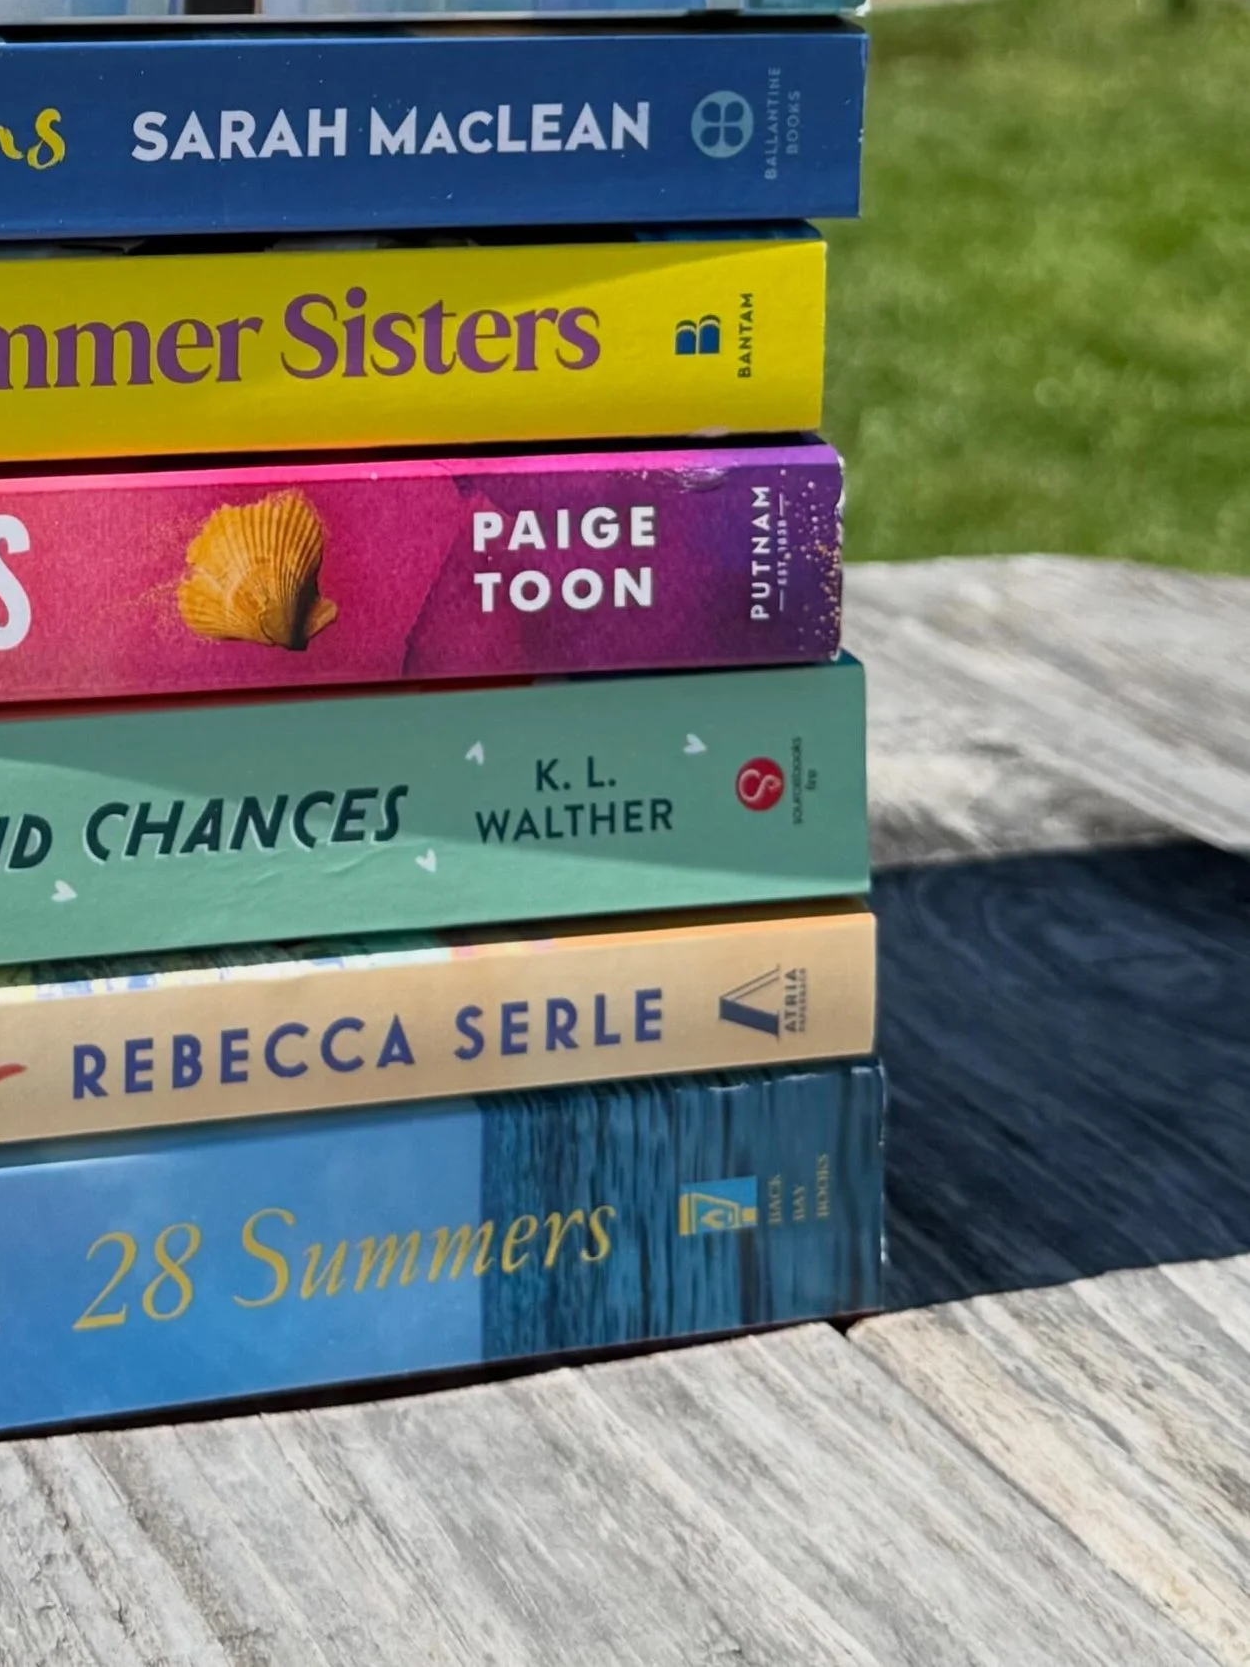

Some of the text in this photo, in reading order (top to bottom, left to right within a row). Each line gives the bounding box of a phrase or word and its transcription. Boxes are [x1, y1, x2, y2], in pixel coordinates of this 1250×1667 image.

[131, 107, 348, 162] SARAH
[763, 66, 782, 180] BALLANTINE
[785, 90, 801, 154] BOOKS
[280, 285, 602, 381] Sisters
[737, 292, 754, 379] BANTAM
[473, 506, 656, 553] PAIGE
[750, 486, 771, 620] PUTNAM
[473, 567, 653, 613] TOON
[535, 755, 616, 793] K. L.
[85, 784, 409, 862] CHANCES
[474, 798, 674, 844] WALTHER
[784, 967, 798, 1033] ATRIA
[72, 987, 663, 1100] REBECCA SERLE
[71, 1204, 617, 1332] 28 Summers
